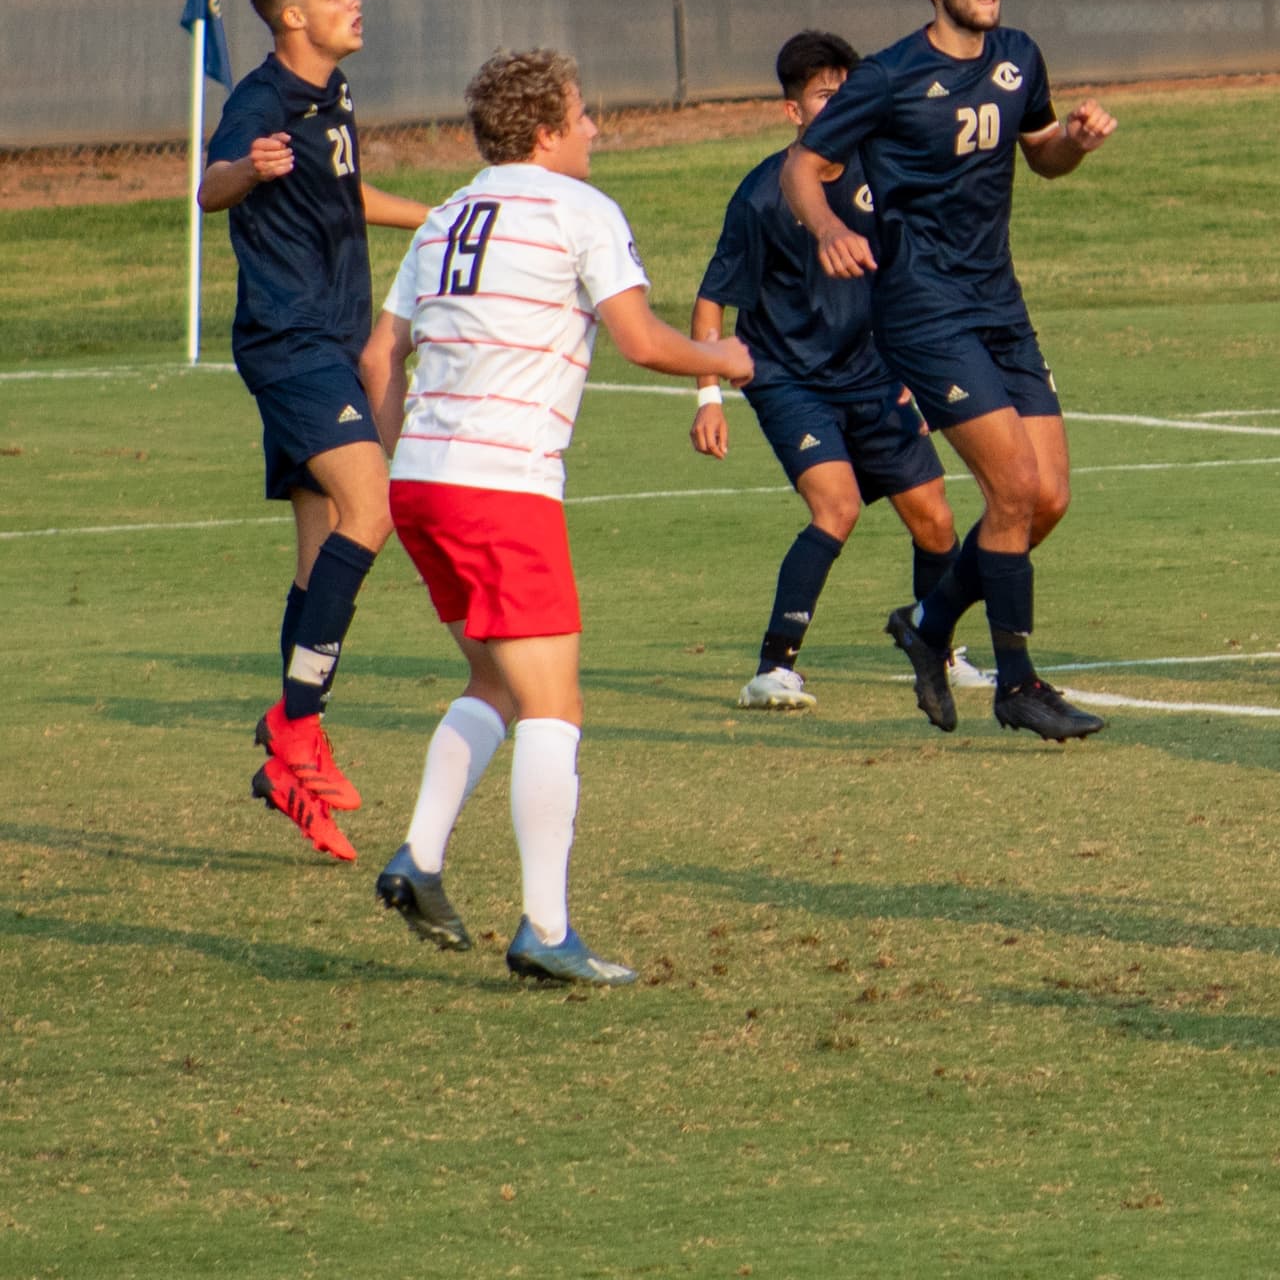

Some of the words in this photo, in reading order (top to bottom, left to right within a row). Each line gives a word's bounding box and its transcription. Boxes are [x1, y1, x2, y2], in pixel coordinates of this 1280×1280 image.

[326, 124, 355, 177] 21
[955, 103, 1001, 156] 20
[436, 200, 501, 297] 19
